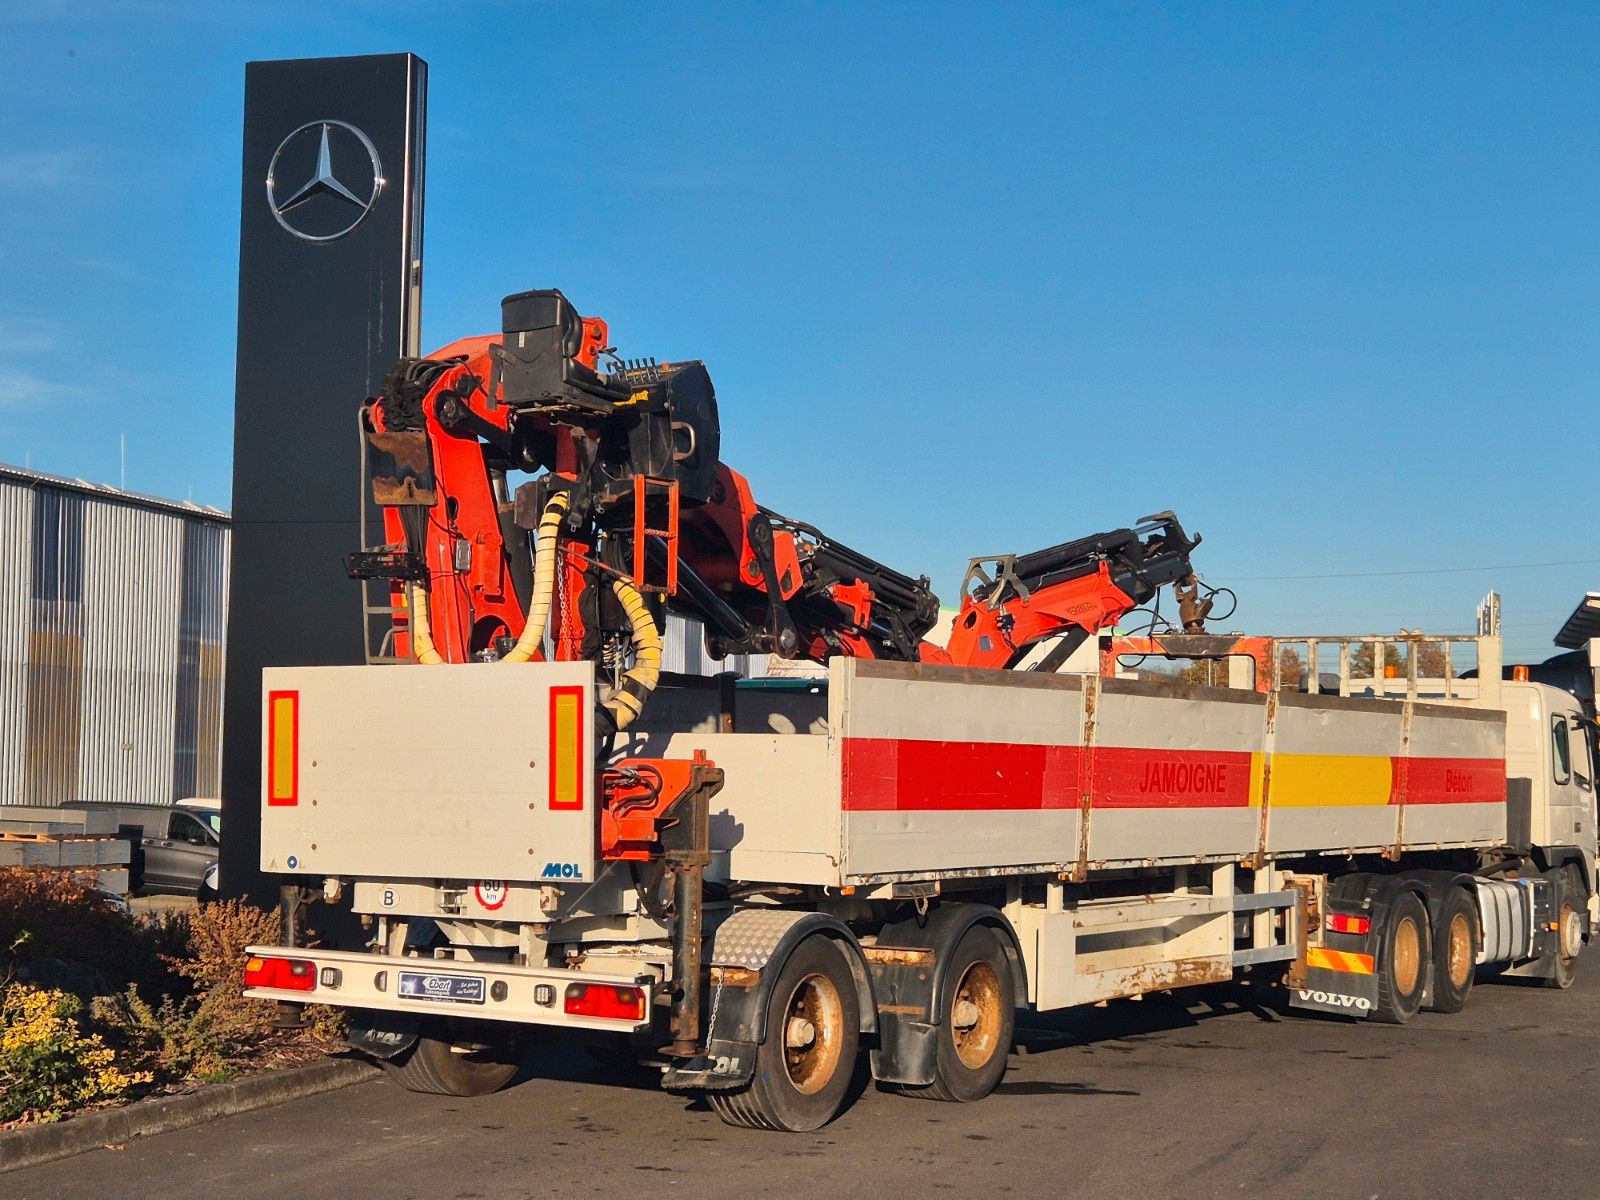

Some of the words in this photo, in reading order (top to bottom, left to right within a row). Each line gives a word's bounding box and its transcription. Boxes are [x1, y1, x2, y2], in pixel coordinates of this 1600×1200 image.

[1140, 762, 1227, 793] JAMOIGNE
[541, 863, 583, 878] MOL
[384, 890, 394, 906] B
[486, 892, 497, 901] km
[1298, 989, 1371, 1010] VOLVO
